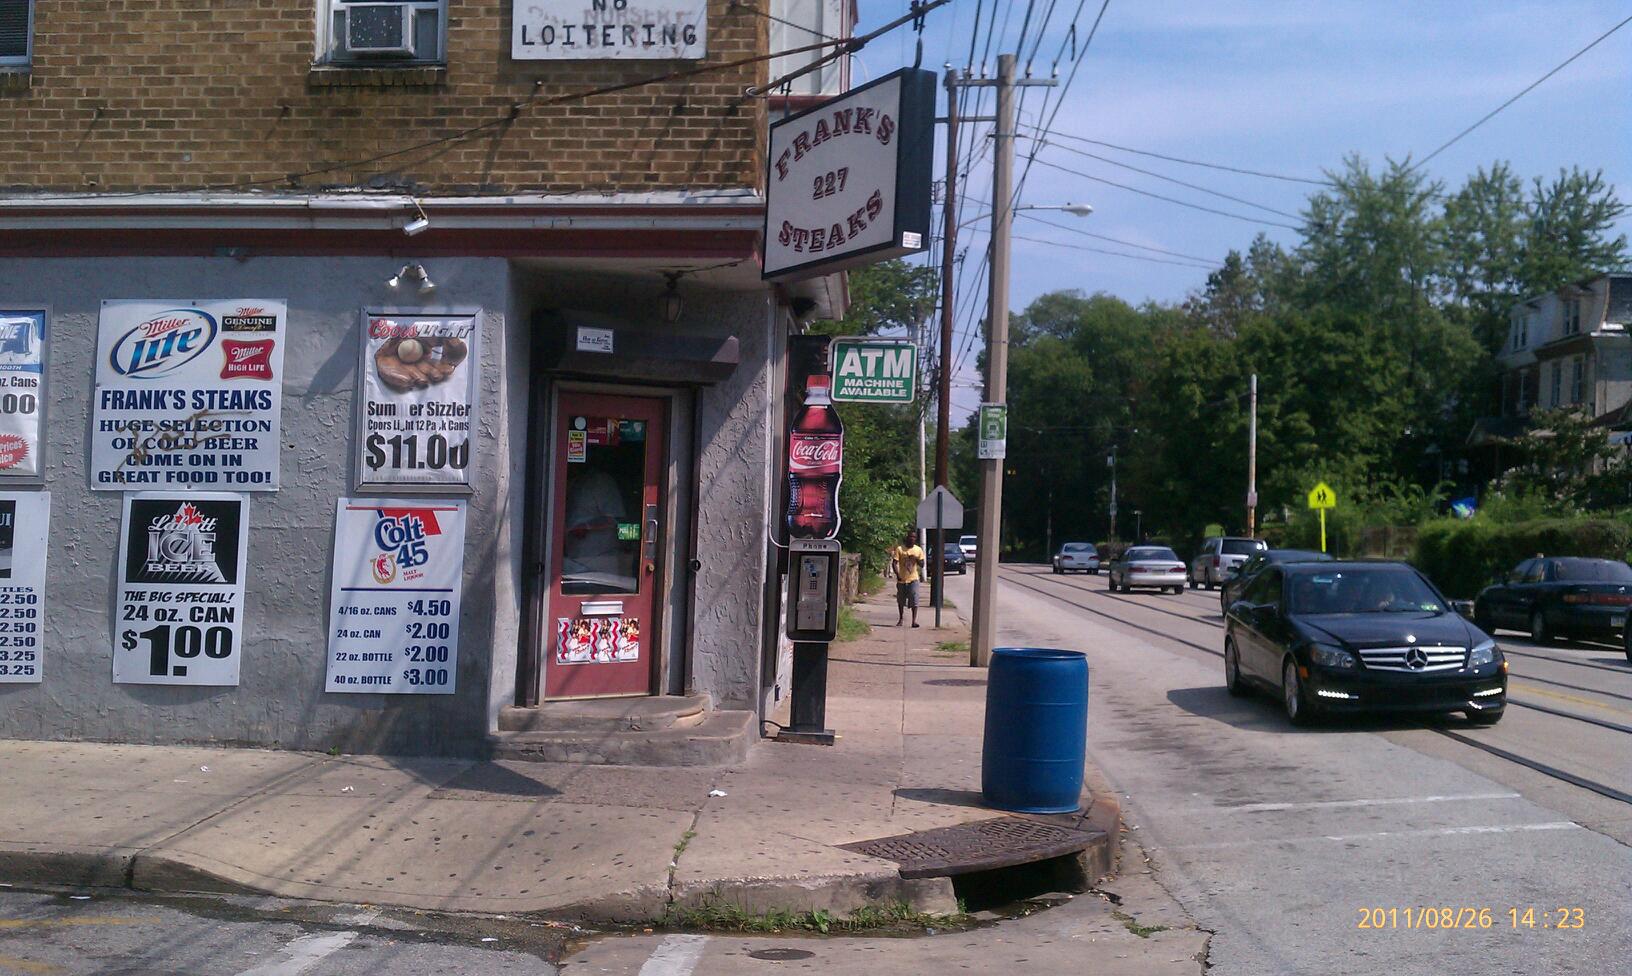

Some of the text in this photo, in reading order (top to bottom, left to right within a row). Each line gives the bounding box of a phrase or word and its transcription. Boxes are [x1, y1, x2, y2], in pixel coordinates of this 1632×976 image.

[592, 0, 627, 11] NO
[521, 24, 697, 46] LOITERING
[775, 107, 896, 181] FRANK'S
[813, 167, 849, 200] 227
[778, 189, 883, 252] STEAKS
[236, 306, 264, 317] Miller
[139, 318, 190, 339] Miller
[126, 327, 202, 376] Lite
[231, 347, 264, 362] Miller
[839, 349, 910, 378] ATM
[10, 376, 38, 388] Cans
[844, 378, 904, 388] MACHINE
[101, 390, 272, 410] FRANK'S STEAKS
[839, 387, 907, 397] AVAILABLE
[367, 401, 471, 417] Sumer Sizzler
[100, 419, 271, 432] HUGE SELECTION
[368, 419, 391, 431] Coors
[416, 419, 425, 431] 12
[448, 420, 469, 431] Cans
[145, 437, 198, 450] COLD
[204, 438, 258, 450] BEER
[366, 432, 469, 472] $11.00
[792, 440, 839, 461] Coca-Cola
[126, 454, 242, 467] COME ON IN
[99, 471, 271, 483] GREAT FOOD TOO!
[374, 513, 425, 552] Colt
[148, 532, 217, 563] ICE
[396, 541, 429, 569] 45
[148, 563, 211, 573] BEER
[124, 591, 235, 604] THE BIG SPECIAL!
[123, 605, 148, 622] 24
[190, 606, 235, 623] CAN
[338, 606, 359, 616] 4/16
[374, 607, 397, 616] CANS
[407, 600, 451, 616] $4.50
[337, 629, 348, 639] 24
[363, 630, 381, 639] CAN
[405, 623, 450, 640] $2.00
[122, 625, 233, 676] $1.00
[336, 652, 348, 662] 22
[362, 653, 393, 662] BOTTLE
[404, 646, 448, 663] $2.00
[334, 675, 345, 685] 40
[361, 676, 392, 685] BOTTLE
[403, 669, 448, 686] $3.00
